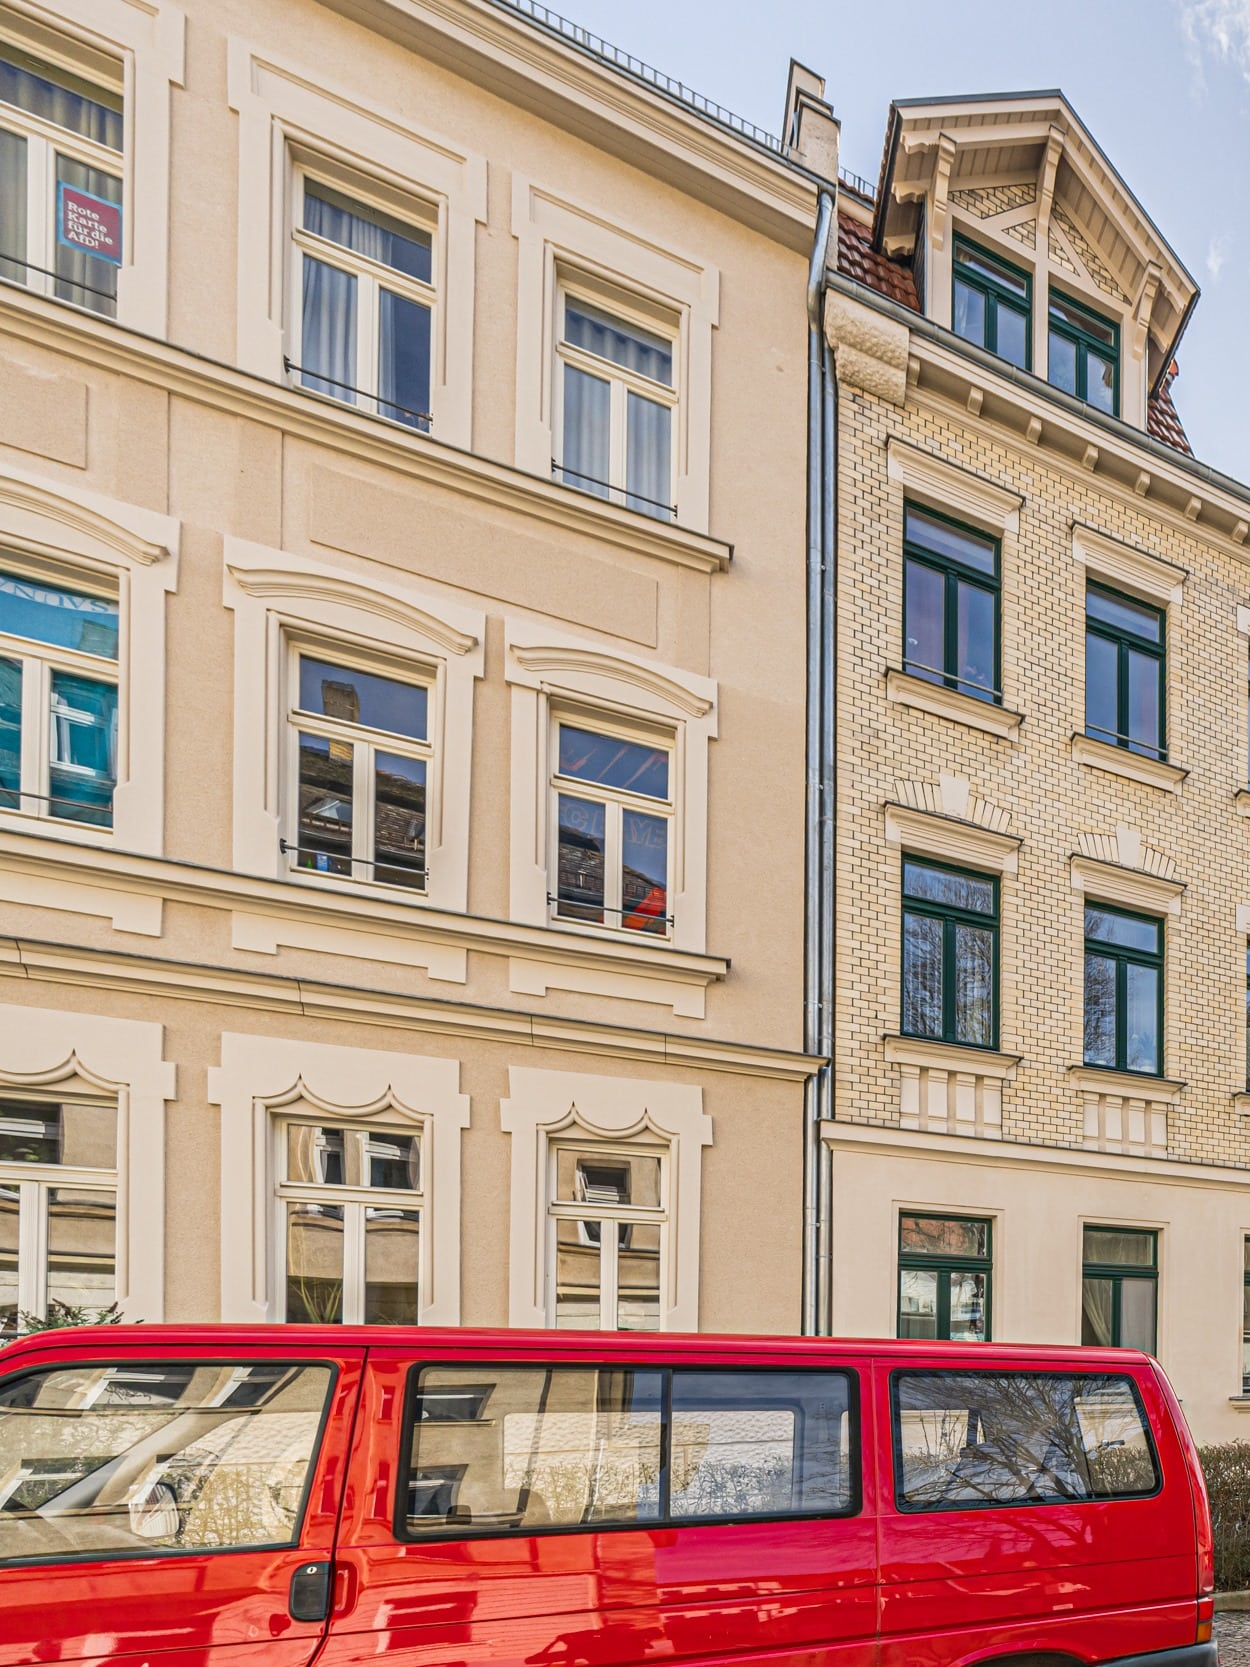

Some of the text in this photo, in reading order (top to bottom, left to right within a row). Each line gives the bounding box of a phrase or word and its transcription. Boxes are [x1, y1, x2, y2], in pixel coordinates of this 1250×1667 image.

[67, 201, 99, 220] Rote
[67, 211, 107, 233] Karte
[68, 221, 113, 245] für die
[68, 232, 99, 249] AfD!
